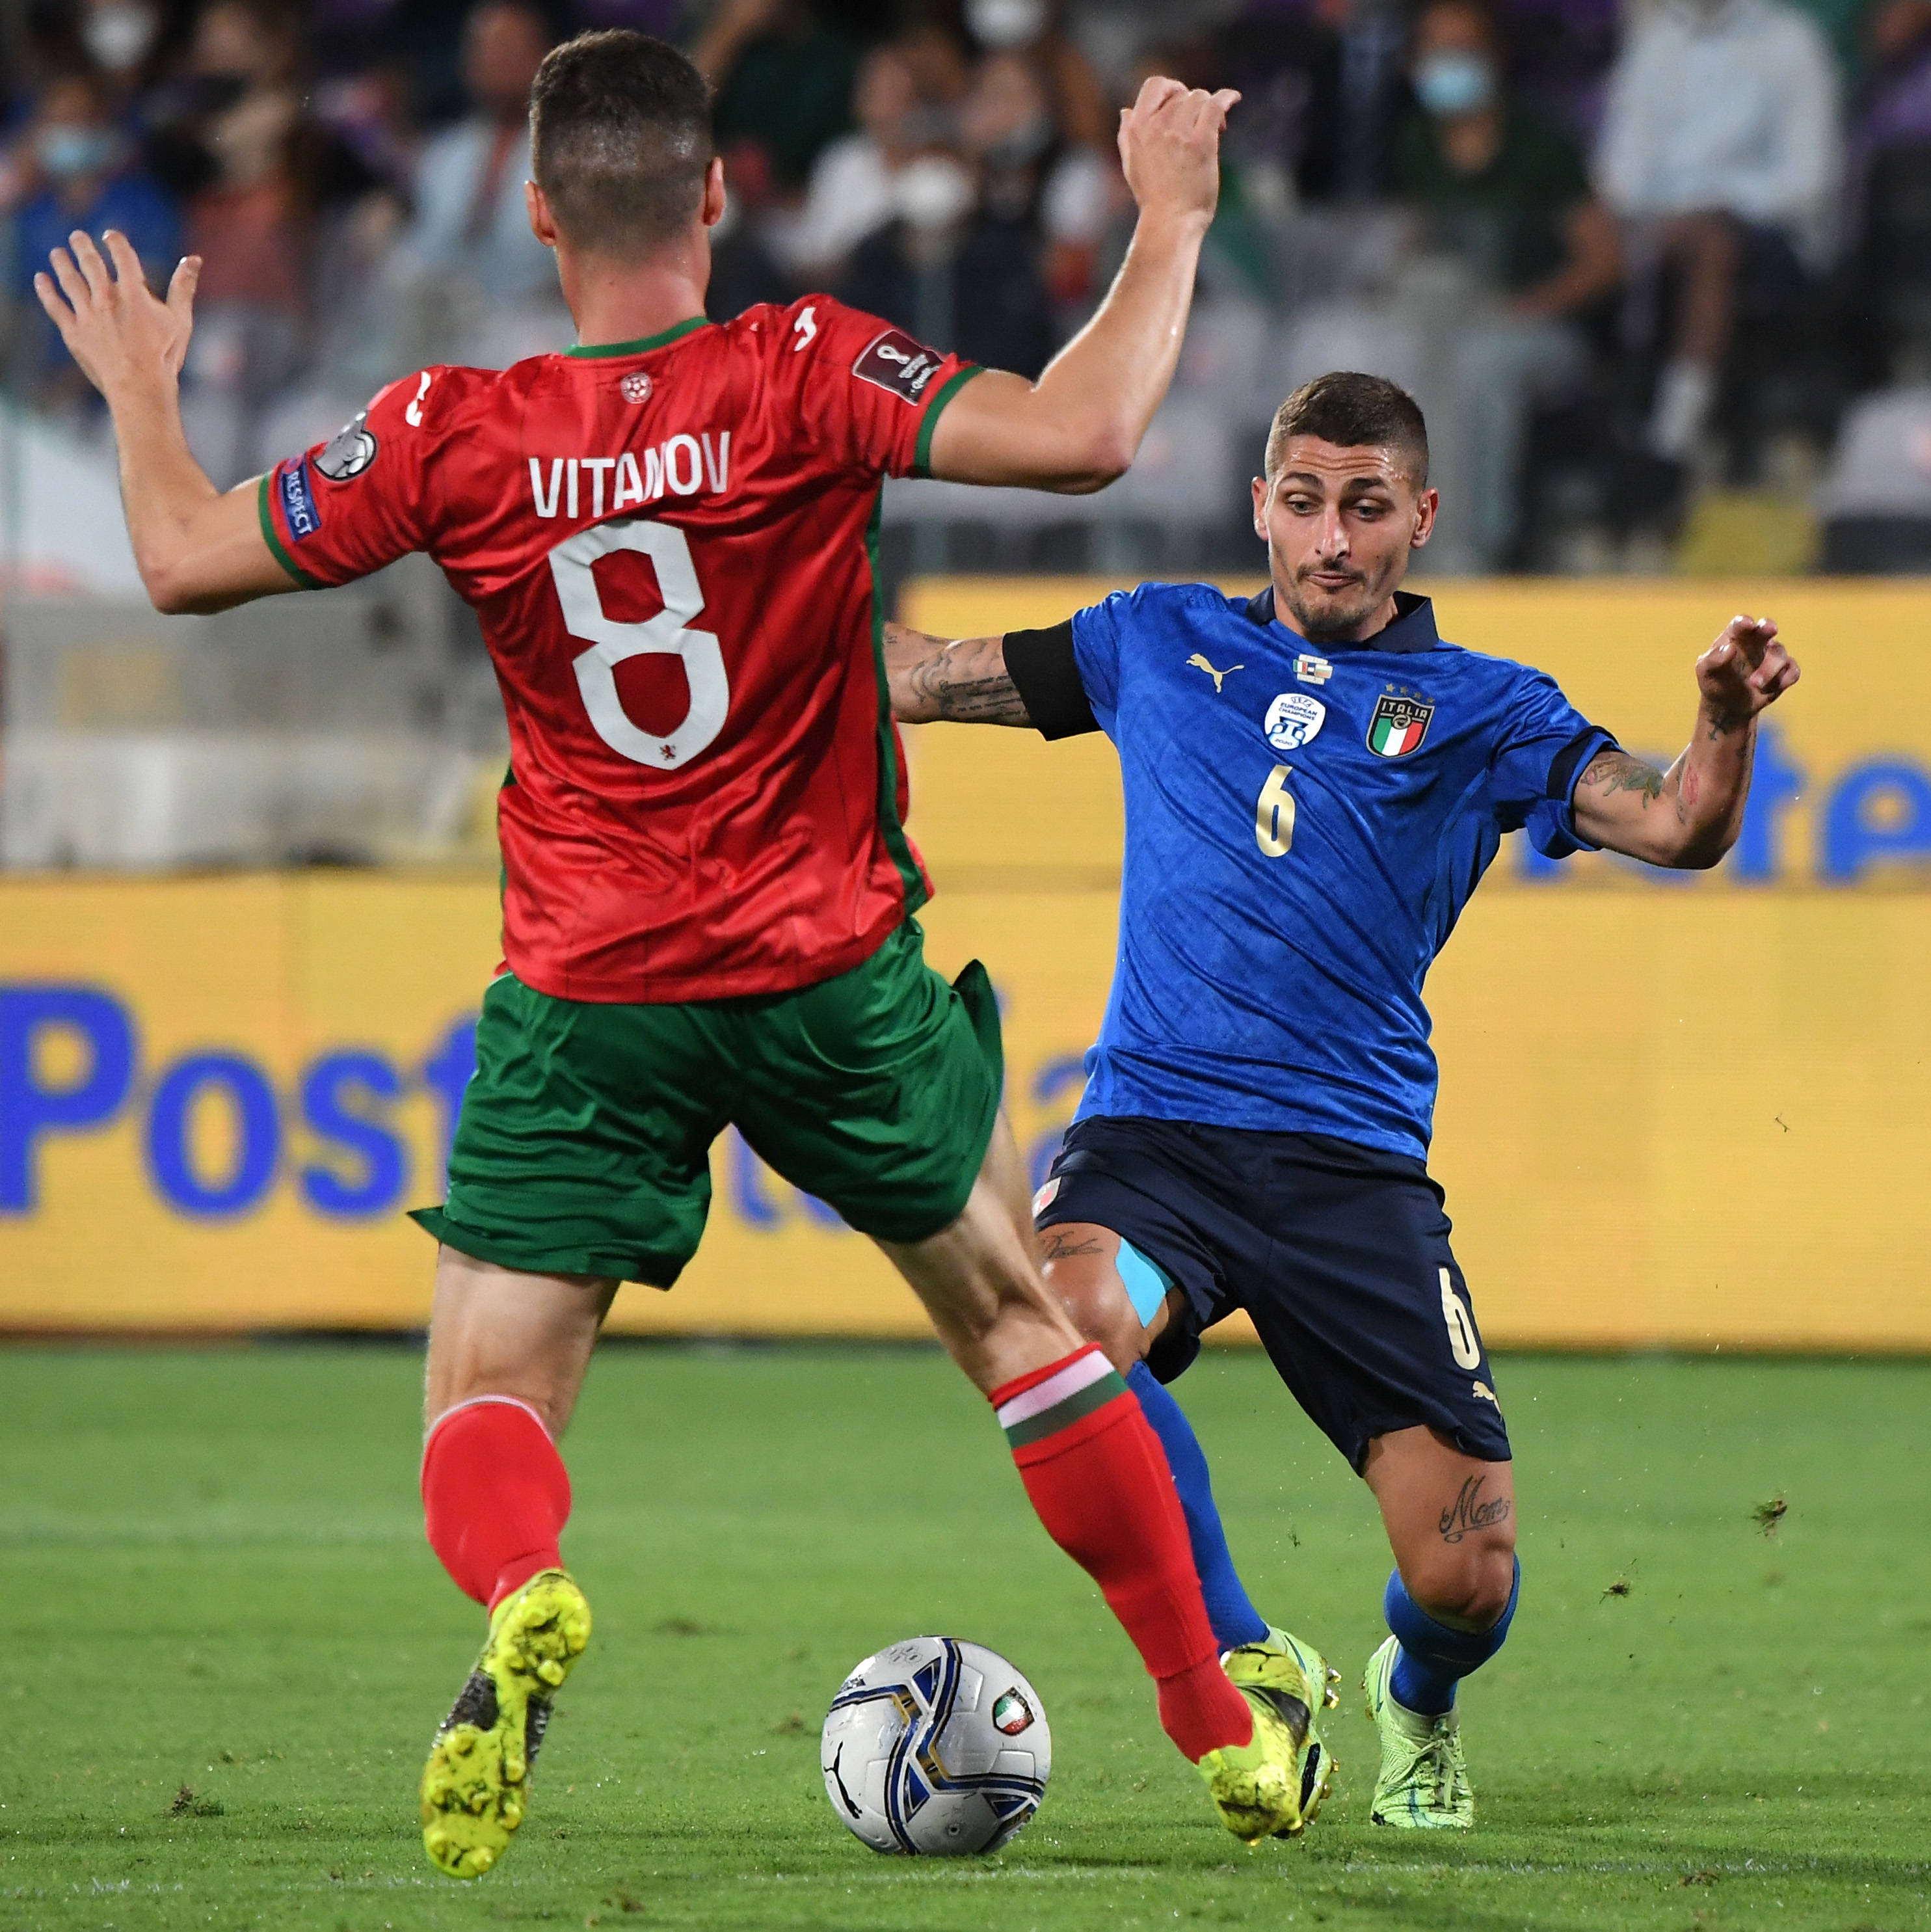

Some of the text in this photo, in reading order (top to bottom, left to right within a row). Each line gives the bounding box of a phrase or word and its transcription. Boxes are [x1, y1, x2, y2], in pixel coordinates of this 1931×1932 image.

[286, 470, 313, 534] RESPECT
[548, 519, 730, 770] 8
[1279, 707, 1315, 721] CHAMPIONS
[1280, 702, 1318, 716] EUROPEAN
[1381, 701, 1428, 719] ITALIA
[1255, 764, 1296, 857] 6
[1439, 1267, 1480, 1370] 6
